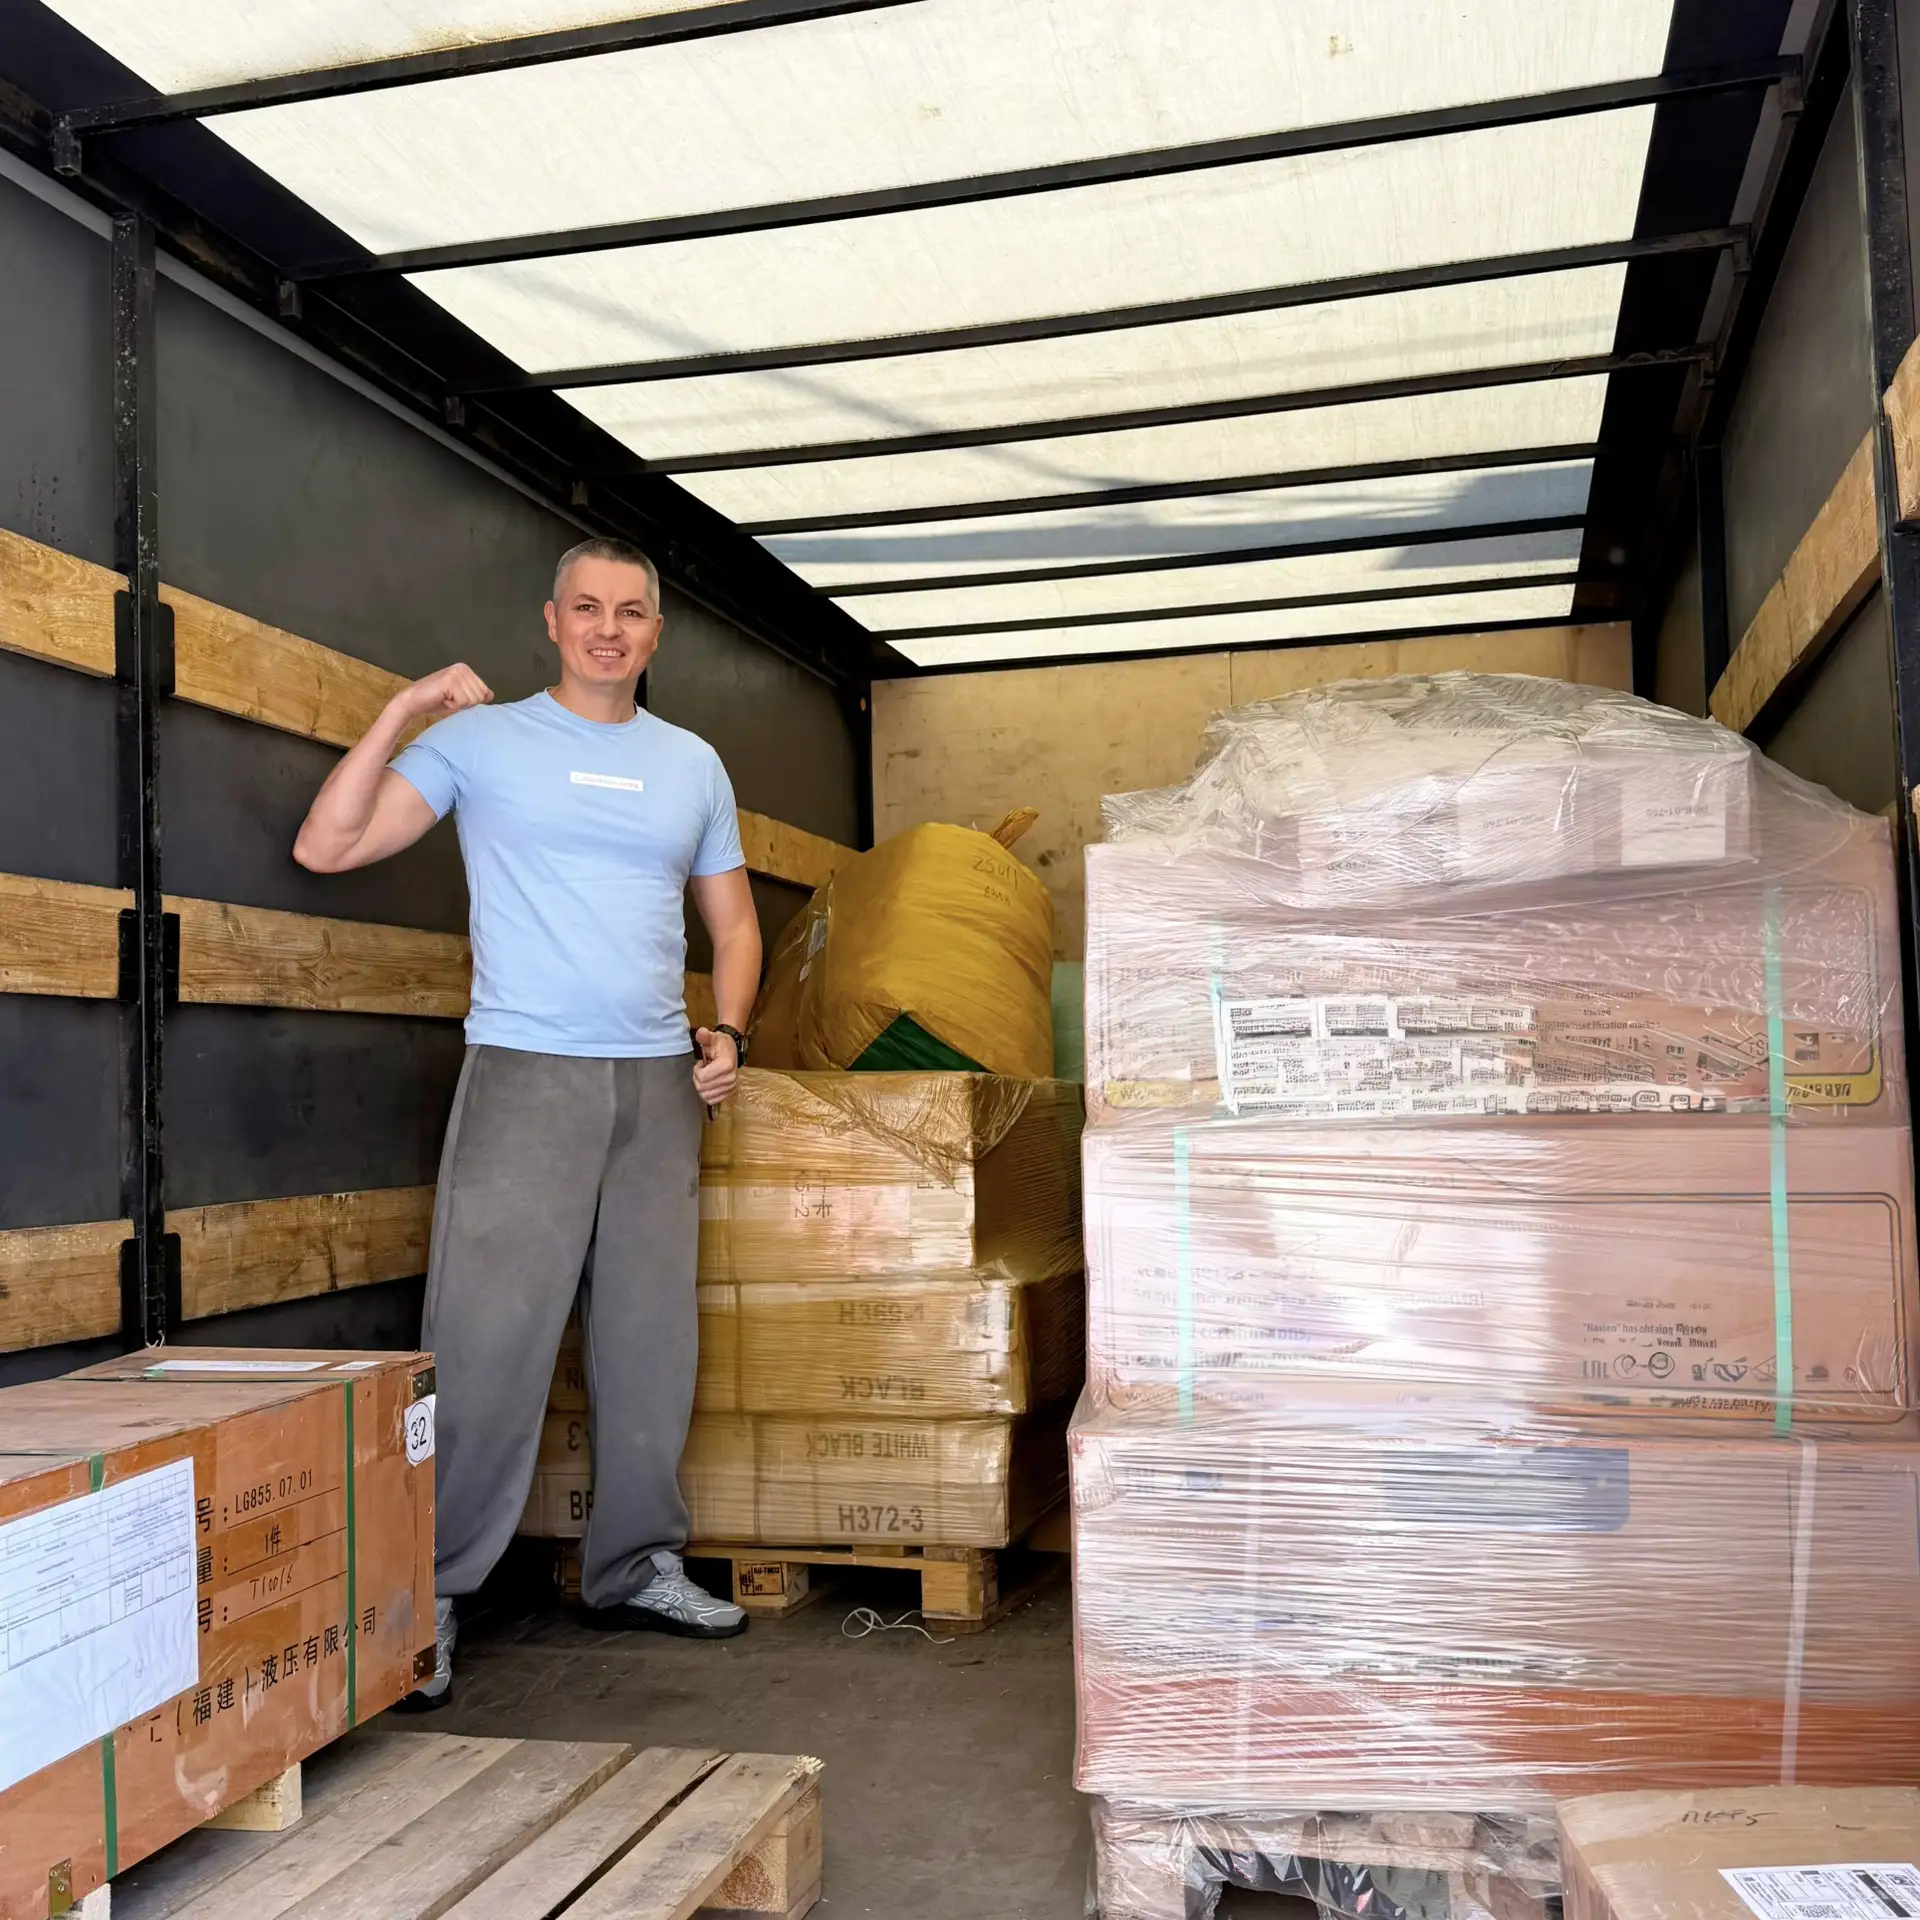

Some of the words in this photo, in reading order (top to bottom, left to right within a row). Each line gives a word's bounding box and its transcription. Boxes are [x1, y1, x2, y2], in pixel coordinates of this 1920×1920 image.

[839, 1374, 926, 1400] BLACK
[411, 1416, 427, 1450] 32
[806, 1433, 864, 1458] BLACK
[872, 1433, 929, 1458] WHITE
[234, 1468, 313, 1515] LG855.07.01
[838, 1504, 925, 1532] H372-3
